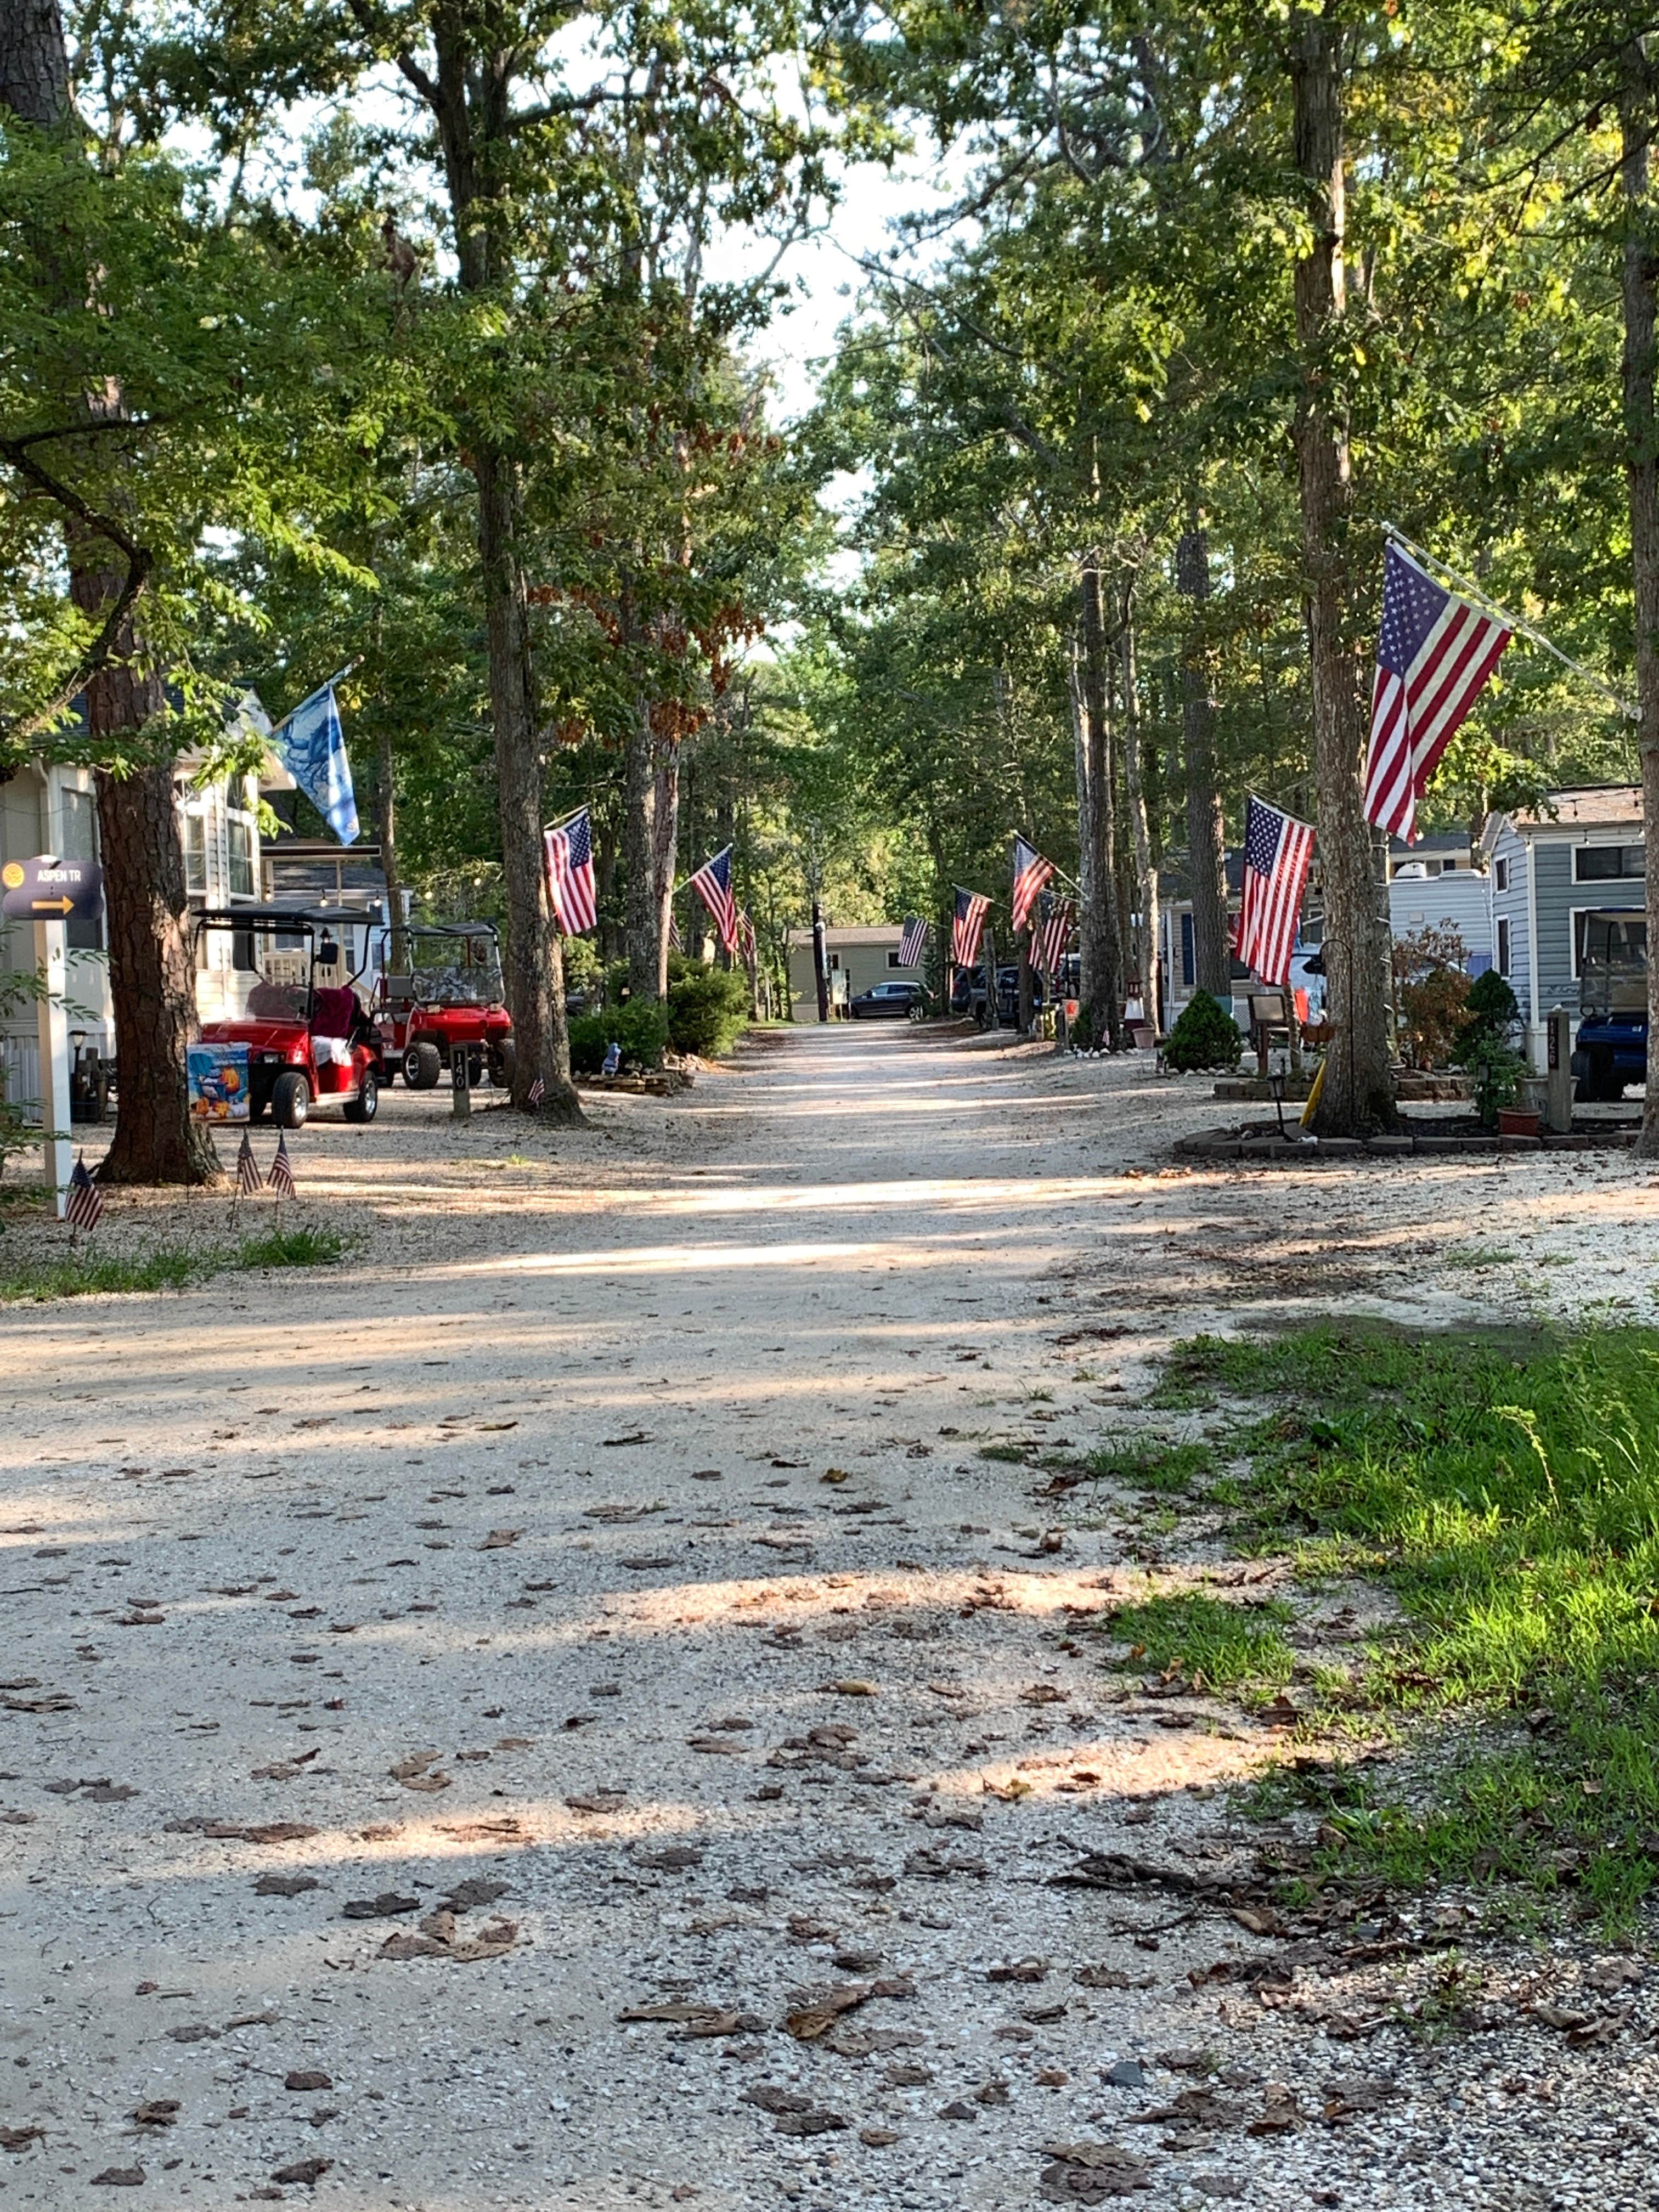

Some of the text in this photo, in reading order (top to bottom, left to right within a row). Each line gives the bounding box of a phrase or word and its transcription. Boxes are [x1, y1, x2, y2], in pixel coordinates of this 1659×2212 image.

[37, 870, 81, 882] ASPEN TR
[456, 1053, 464, 1087] 140
